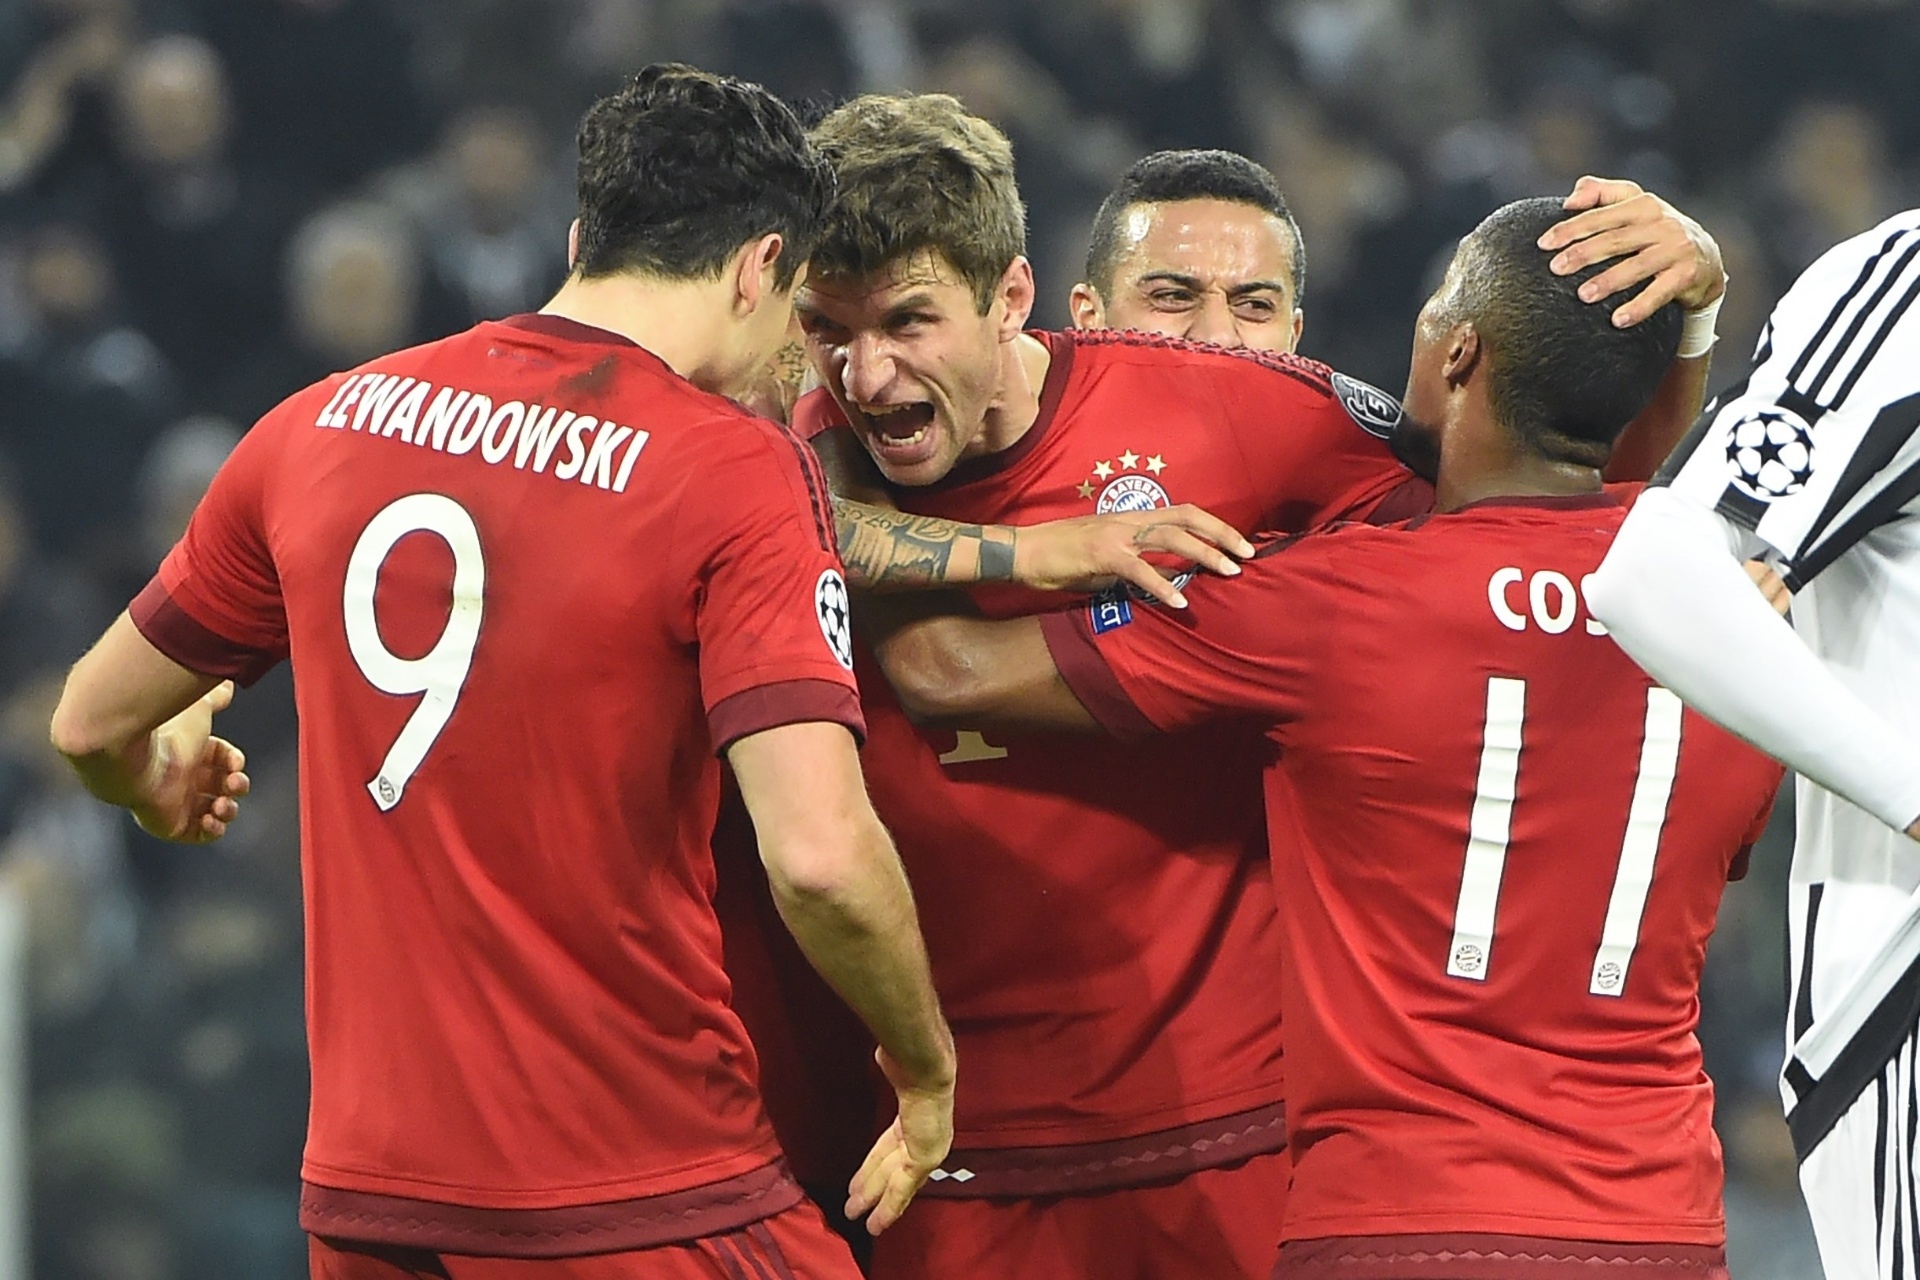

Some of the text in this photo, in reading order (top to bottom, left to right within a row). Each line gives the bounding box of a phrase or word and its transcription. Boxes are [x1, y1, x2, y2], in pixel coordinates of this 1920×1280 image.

[315, 373, 650, 493] LEWANDOWSKI
[1108, 479, 1161, 502] BAYERN
[343, 493, 485, 811] 9
[1446, 677, 1683, 997] 11
